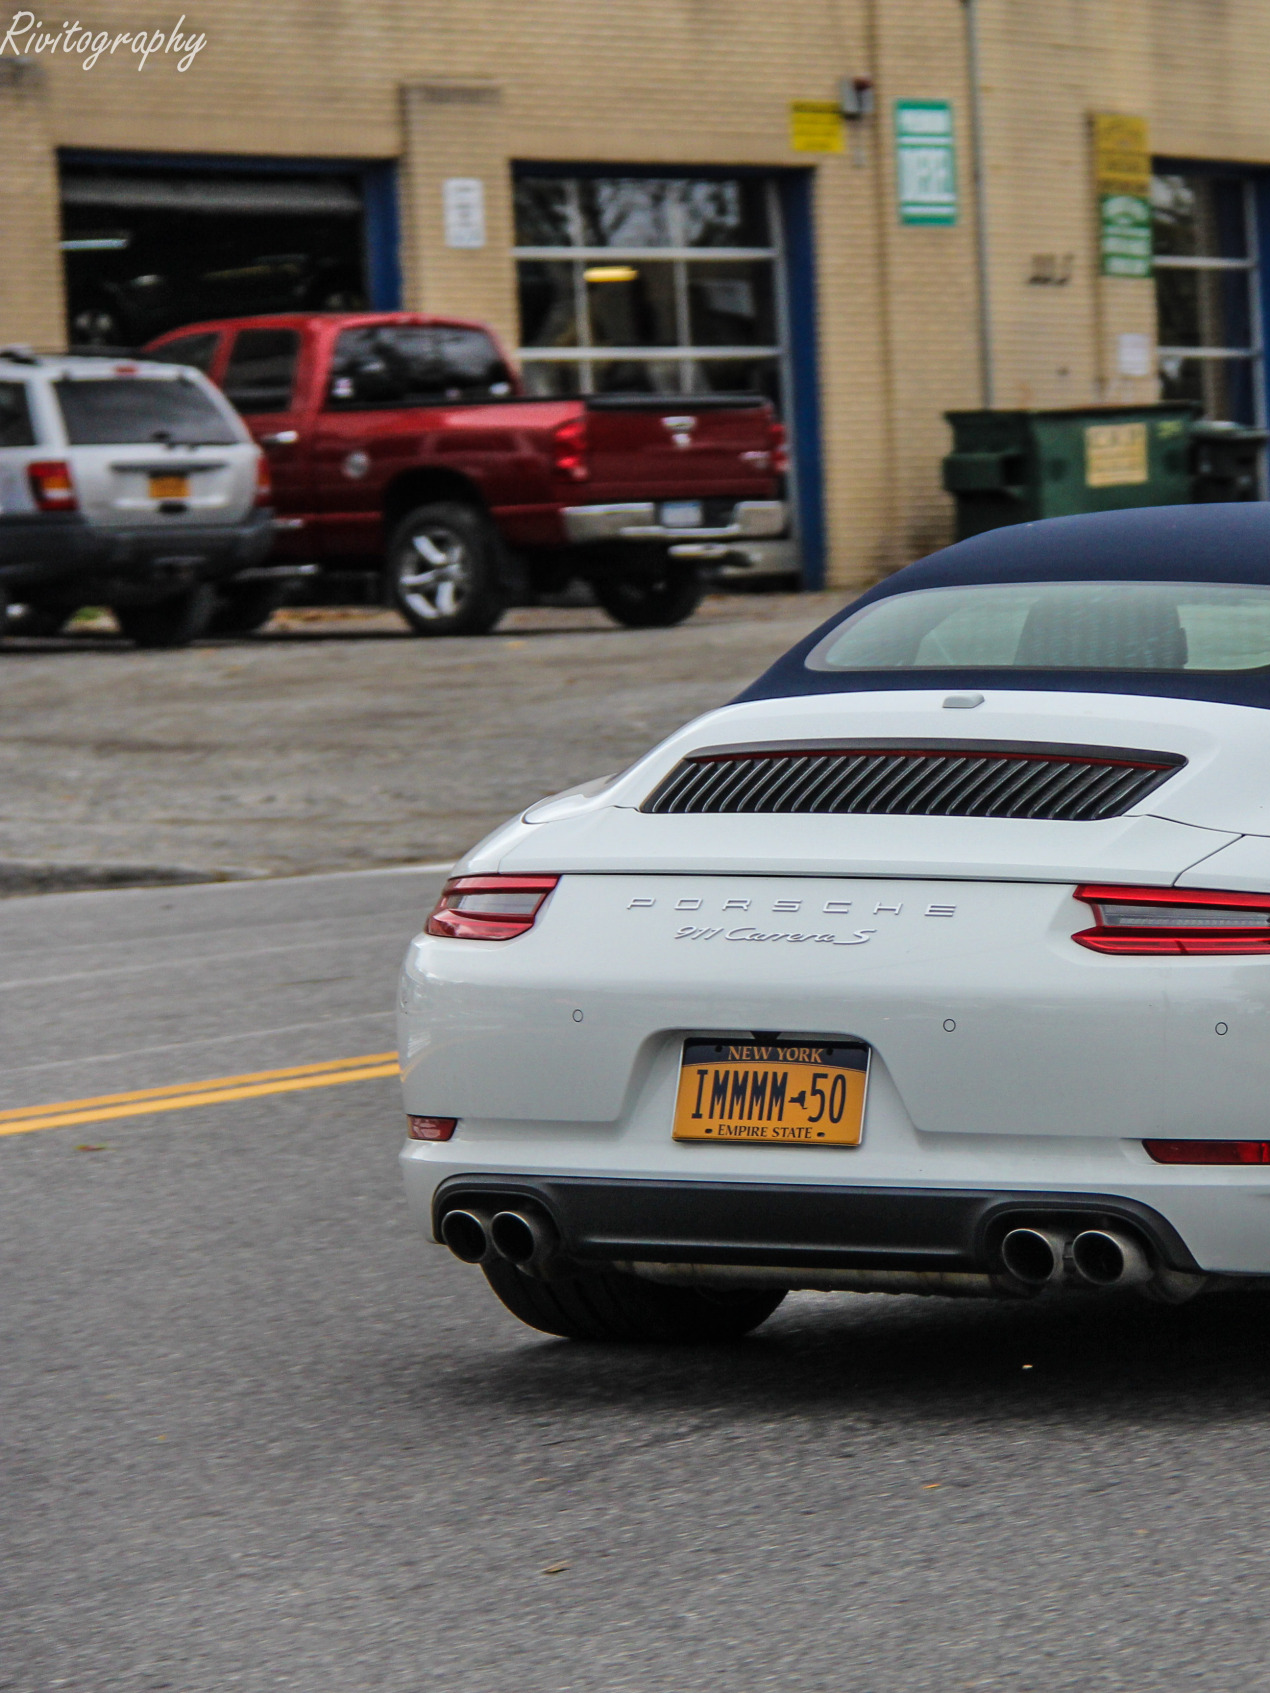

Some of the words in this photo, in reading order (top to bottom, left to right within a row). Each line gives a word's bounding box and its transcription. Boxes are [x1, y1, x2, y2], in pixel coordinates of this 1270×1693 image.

[627, 897, 957, 917] PORSCHE
[674, 925, 725, 940] 911
[725, 926, 835, 943] Carrera
[833, 928, 878, 945] S
[727, 1045, 775, 1061] NEW
[776, 1047, 824, 1064] YORK
[717, 1123, 768, 1138] EMPIRE
[771, 1126, 813, 1139] STATE
